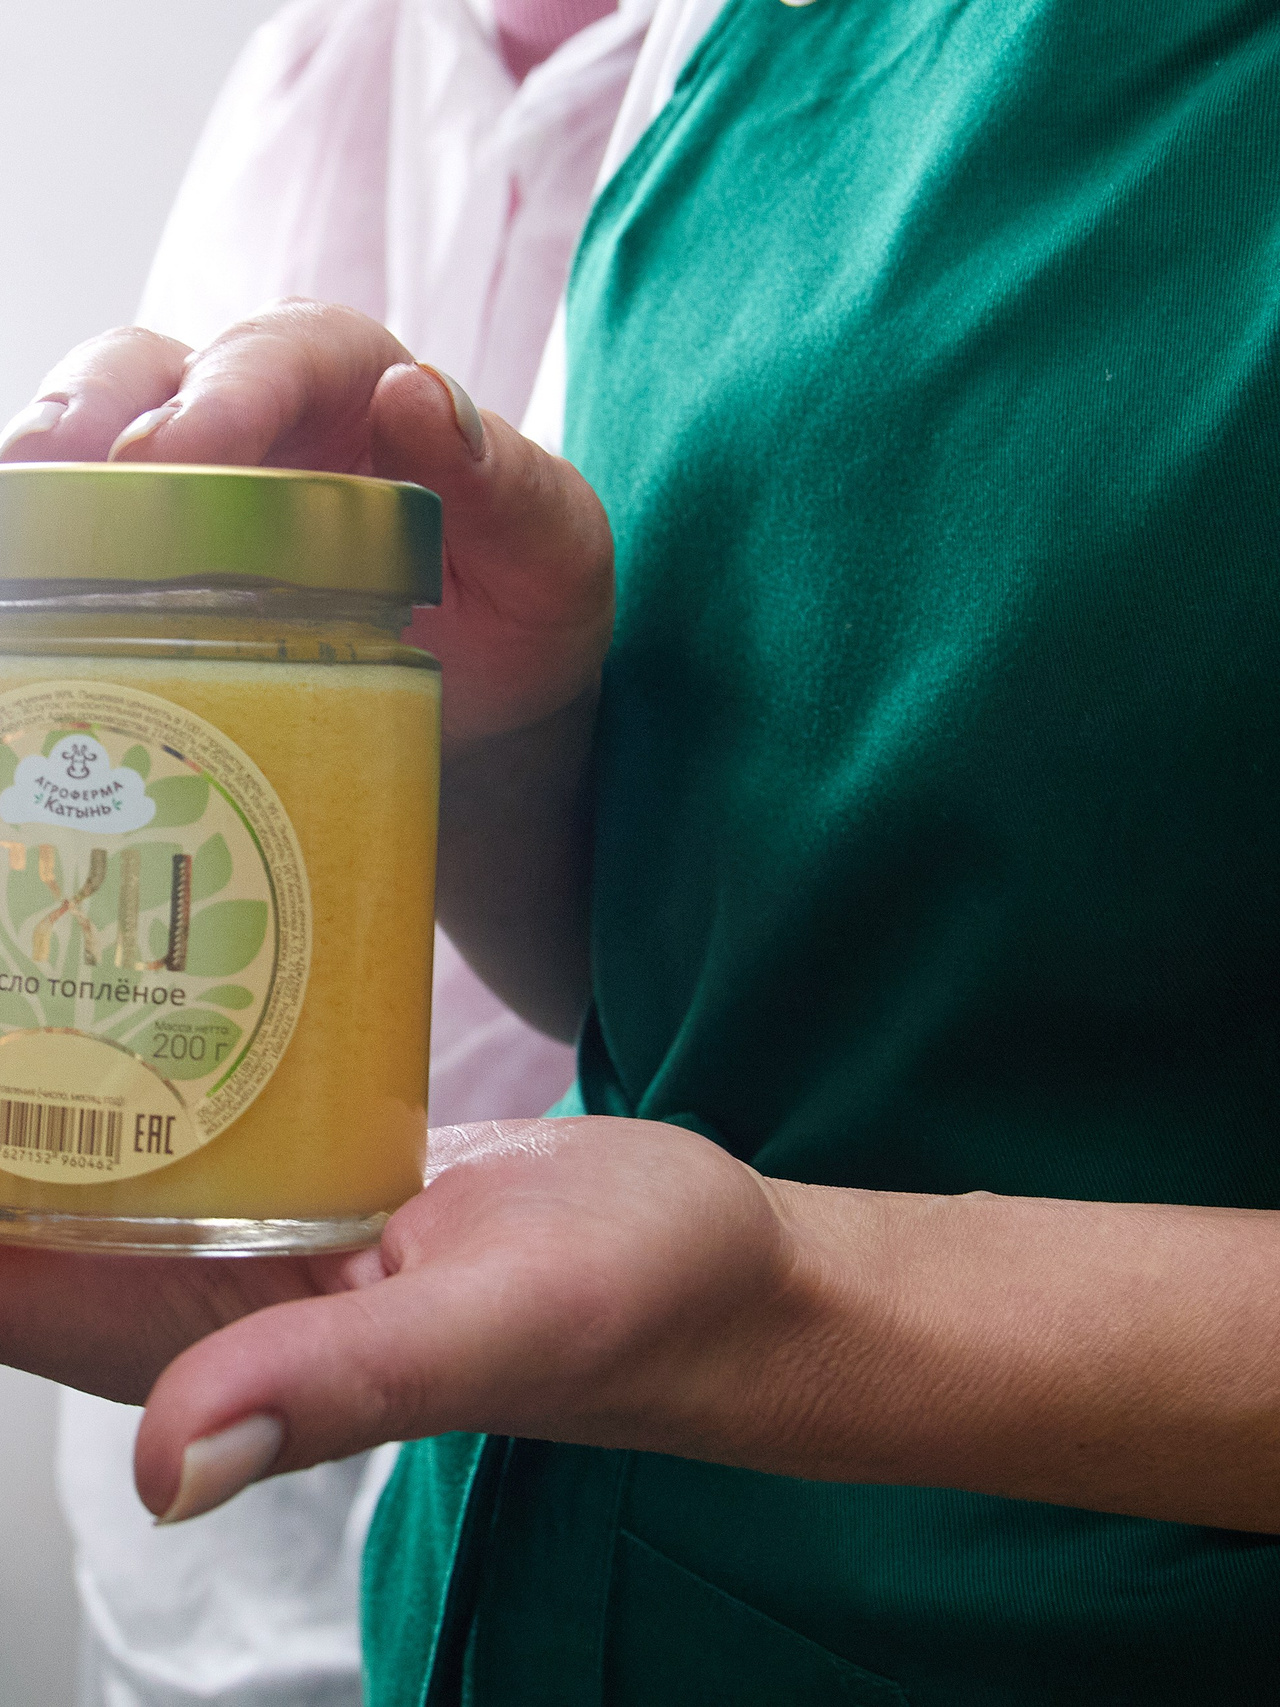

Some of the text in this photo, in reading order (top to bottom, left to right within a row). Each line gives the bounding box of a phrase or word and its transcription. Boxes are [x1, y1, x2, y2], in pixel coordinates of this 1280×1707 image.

[35, 776, 123, 801] АГРОФЕРМА
[44, 796, 112, 819] Катынь
[48, 978, 186, 1006] топлёное
[153, 1033, 228, 1061] 200 г
